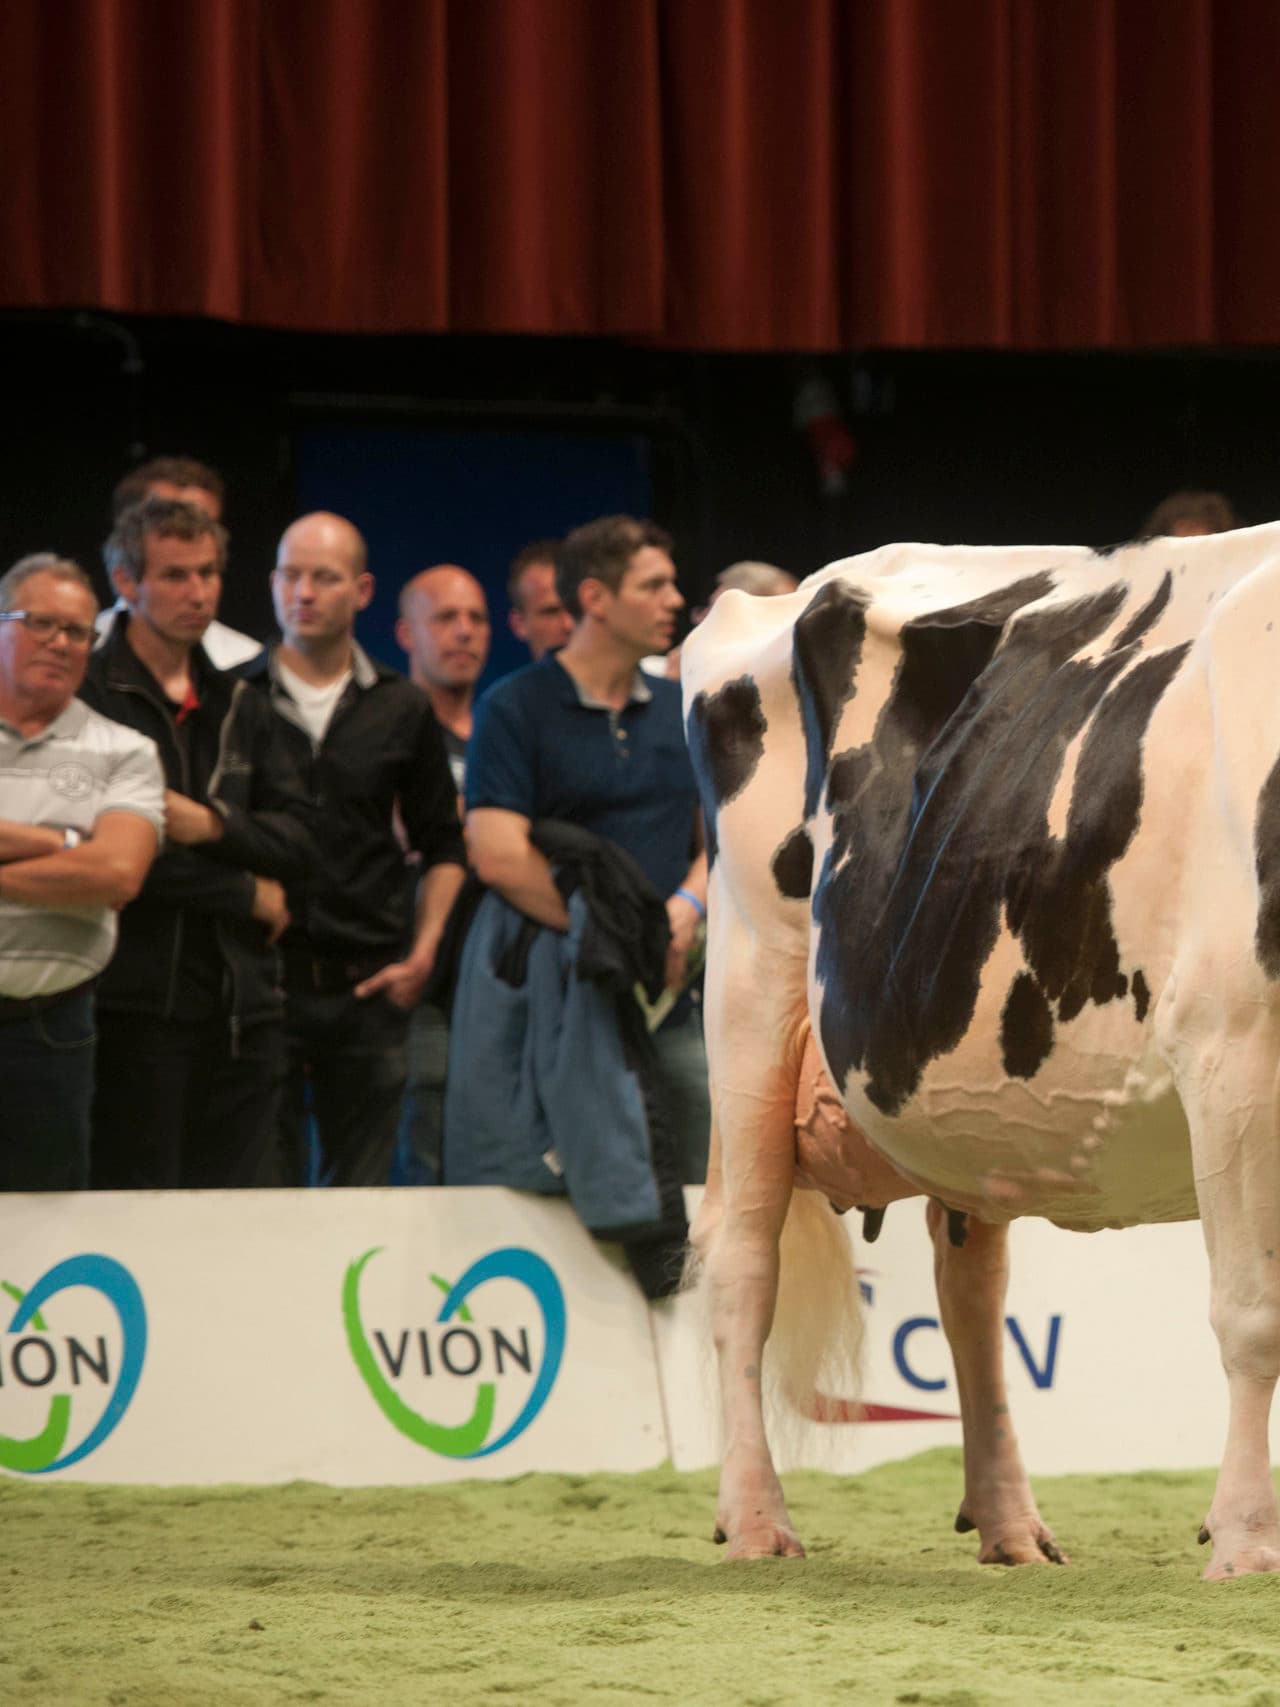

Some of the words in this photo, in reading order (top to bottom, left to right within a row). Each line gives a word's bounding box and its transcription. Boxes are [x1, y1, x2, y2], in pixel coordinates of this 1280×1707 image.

[0, 1336, 109, 1388] ON
[372, 1328, 532, 1378] VION
[893, 1315, 1061, 1390] CV
